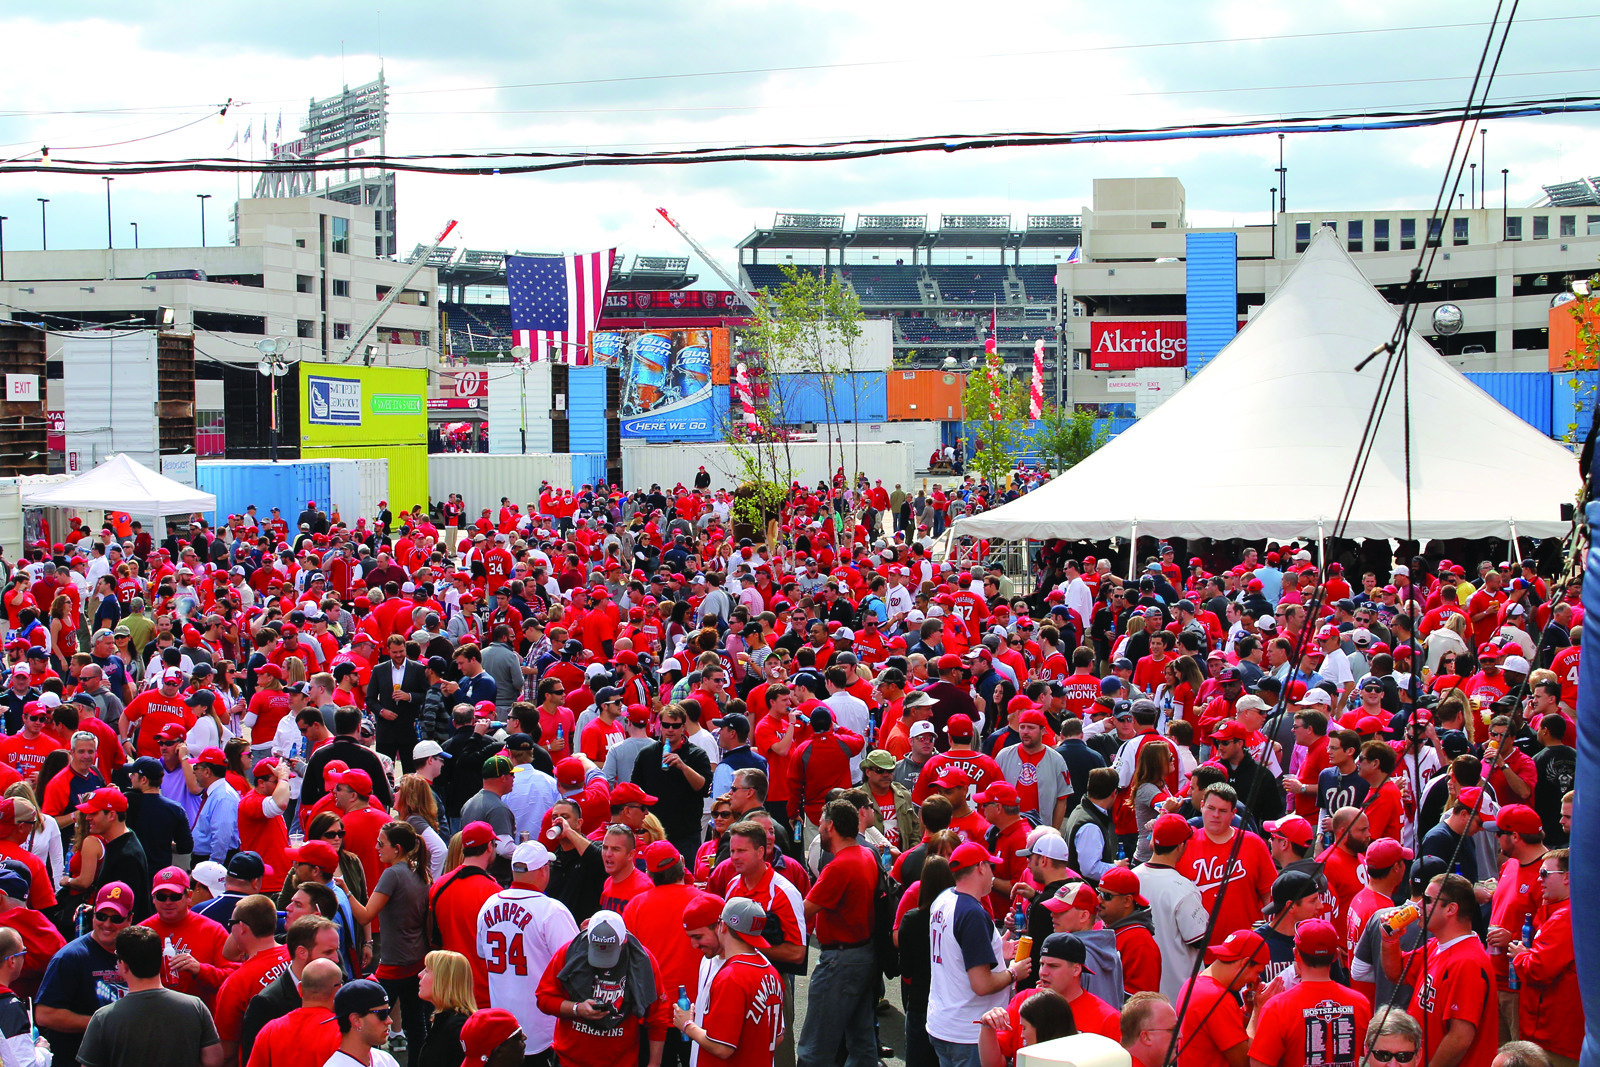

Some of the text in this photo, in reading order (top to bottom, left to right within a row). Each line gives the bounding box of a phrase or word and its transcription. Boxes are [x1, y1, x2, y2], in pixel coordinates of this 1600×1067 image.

[641, 337, 672, 349] BUD
[1094, 329, 1186, 360] Akridge
[681, 350, 709, 358] BUD
[14, 381, 31, 394] EXIT
[489, 563, 503, 575] 34
[122, 589, 136, 602] 37
[1067, 691, 1097, 699] WONK
[147, 702, 183, 717] NATIONALS
[484, 903, 532, 931] HARPER
[592, 933, 616, 943] PLAYOFFS
[486, 931, 528, 976] 34
[1303, 1006, 1354, 1017] POSTSEASON
[572, 1021, 624, 1037] TERRAPINS
